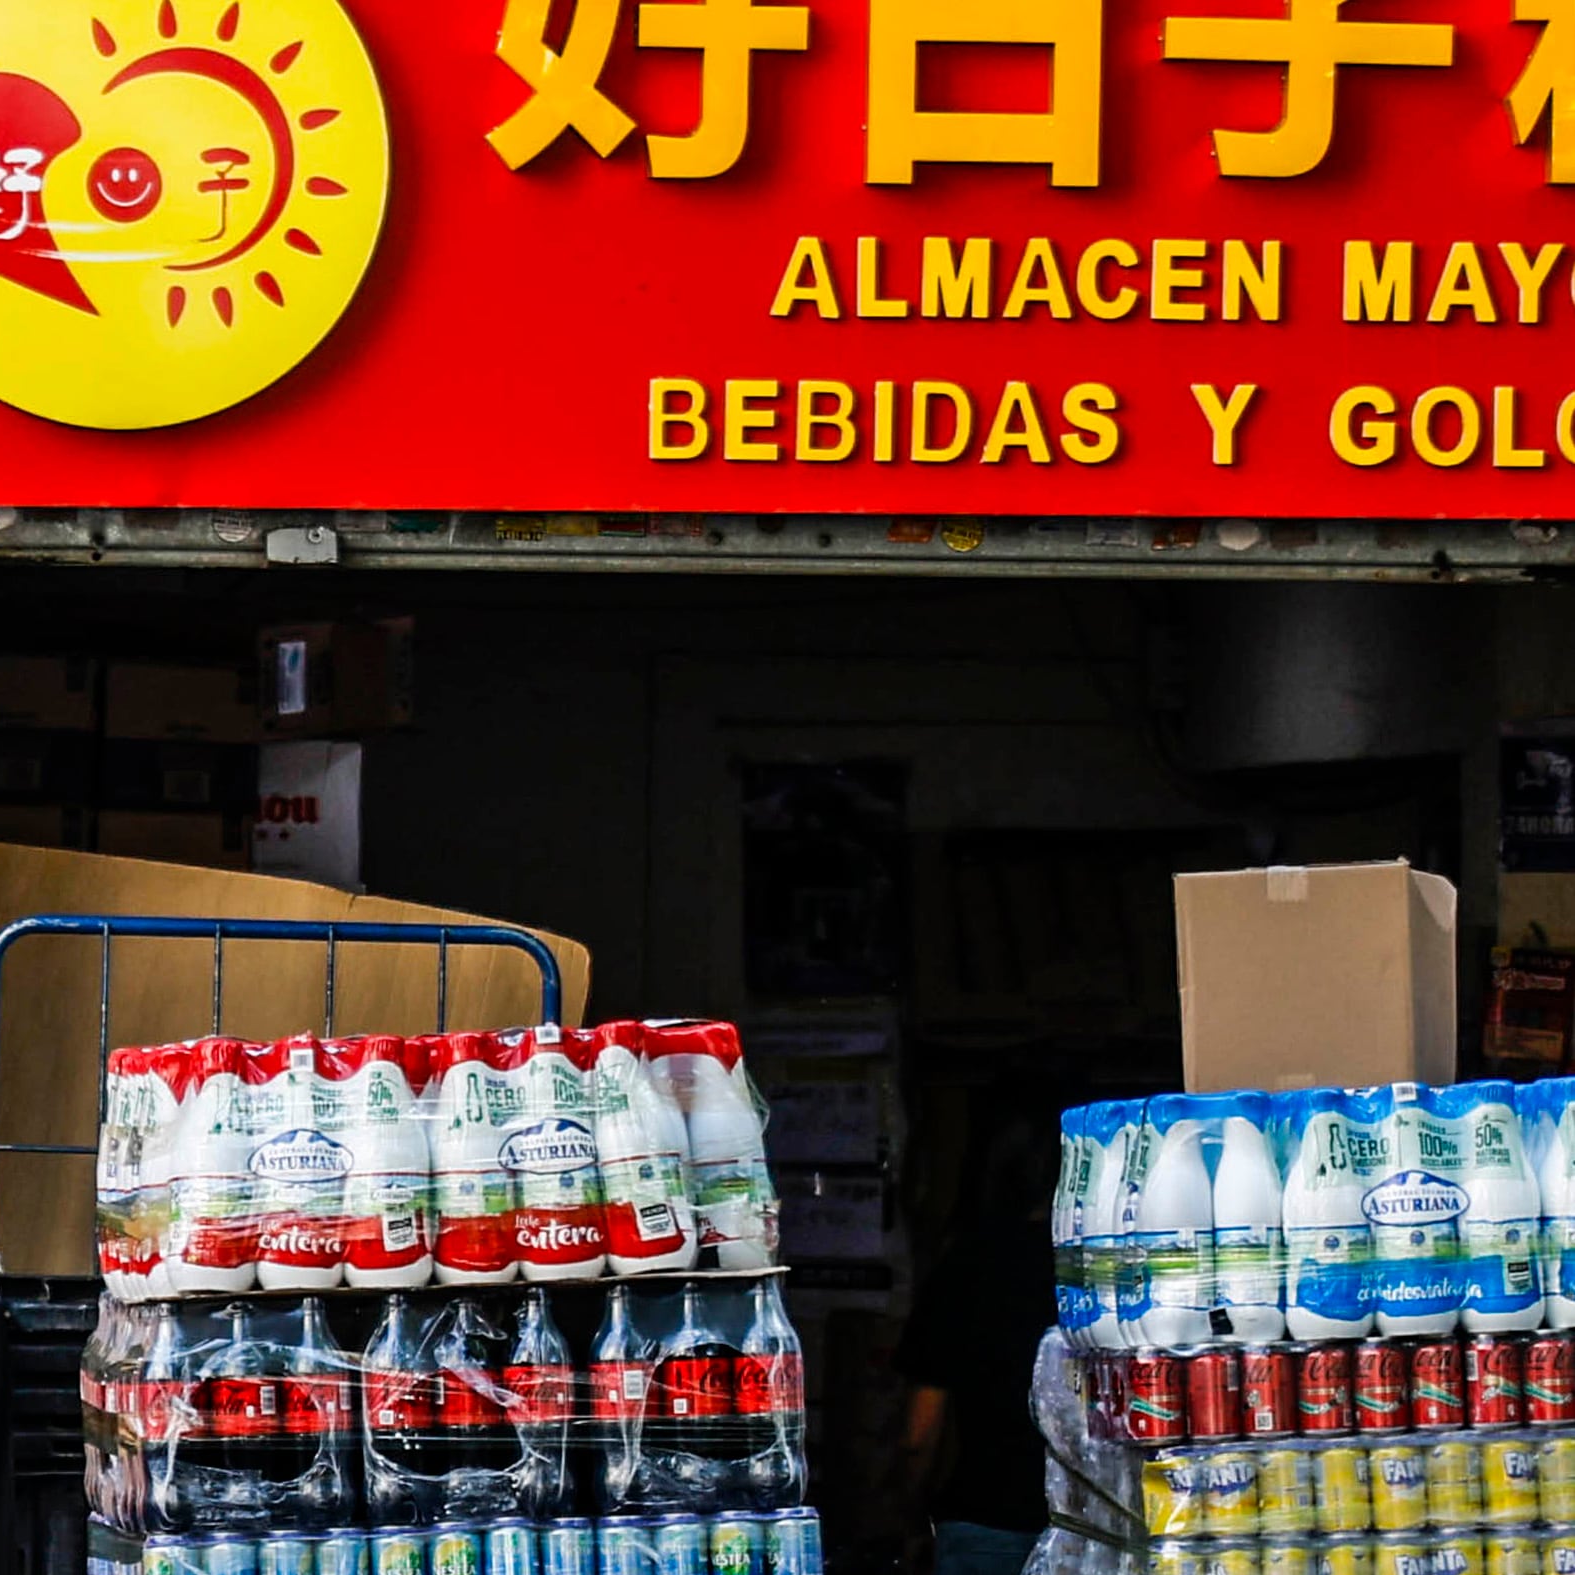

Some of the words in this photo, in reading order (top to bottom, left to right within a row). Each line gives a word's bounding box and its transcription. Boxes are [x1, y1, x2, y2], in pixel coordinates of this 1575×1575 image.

[768, 236, 1282, 323] ALMACEN
[1342, 240, 1575, 324] MAY
[647, 377, 1121, 465] BEBIDAS
[1190, 383, 1256, 466] Y
[1347, 1137, 1390, 1156] CERO
[257, 1154, 347, 1171] ASTURIANA
[1368, 1197, 1461, 1216] ASTURIANA
[258, 1225, 344, 1254] entera
[515, 1219, 604, 1252] entera
